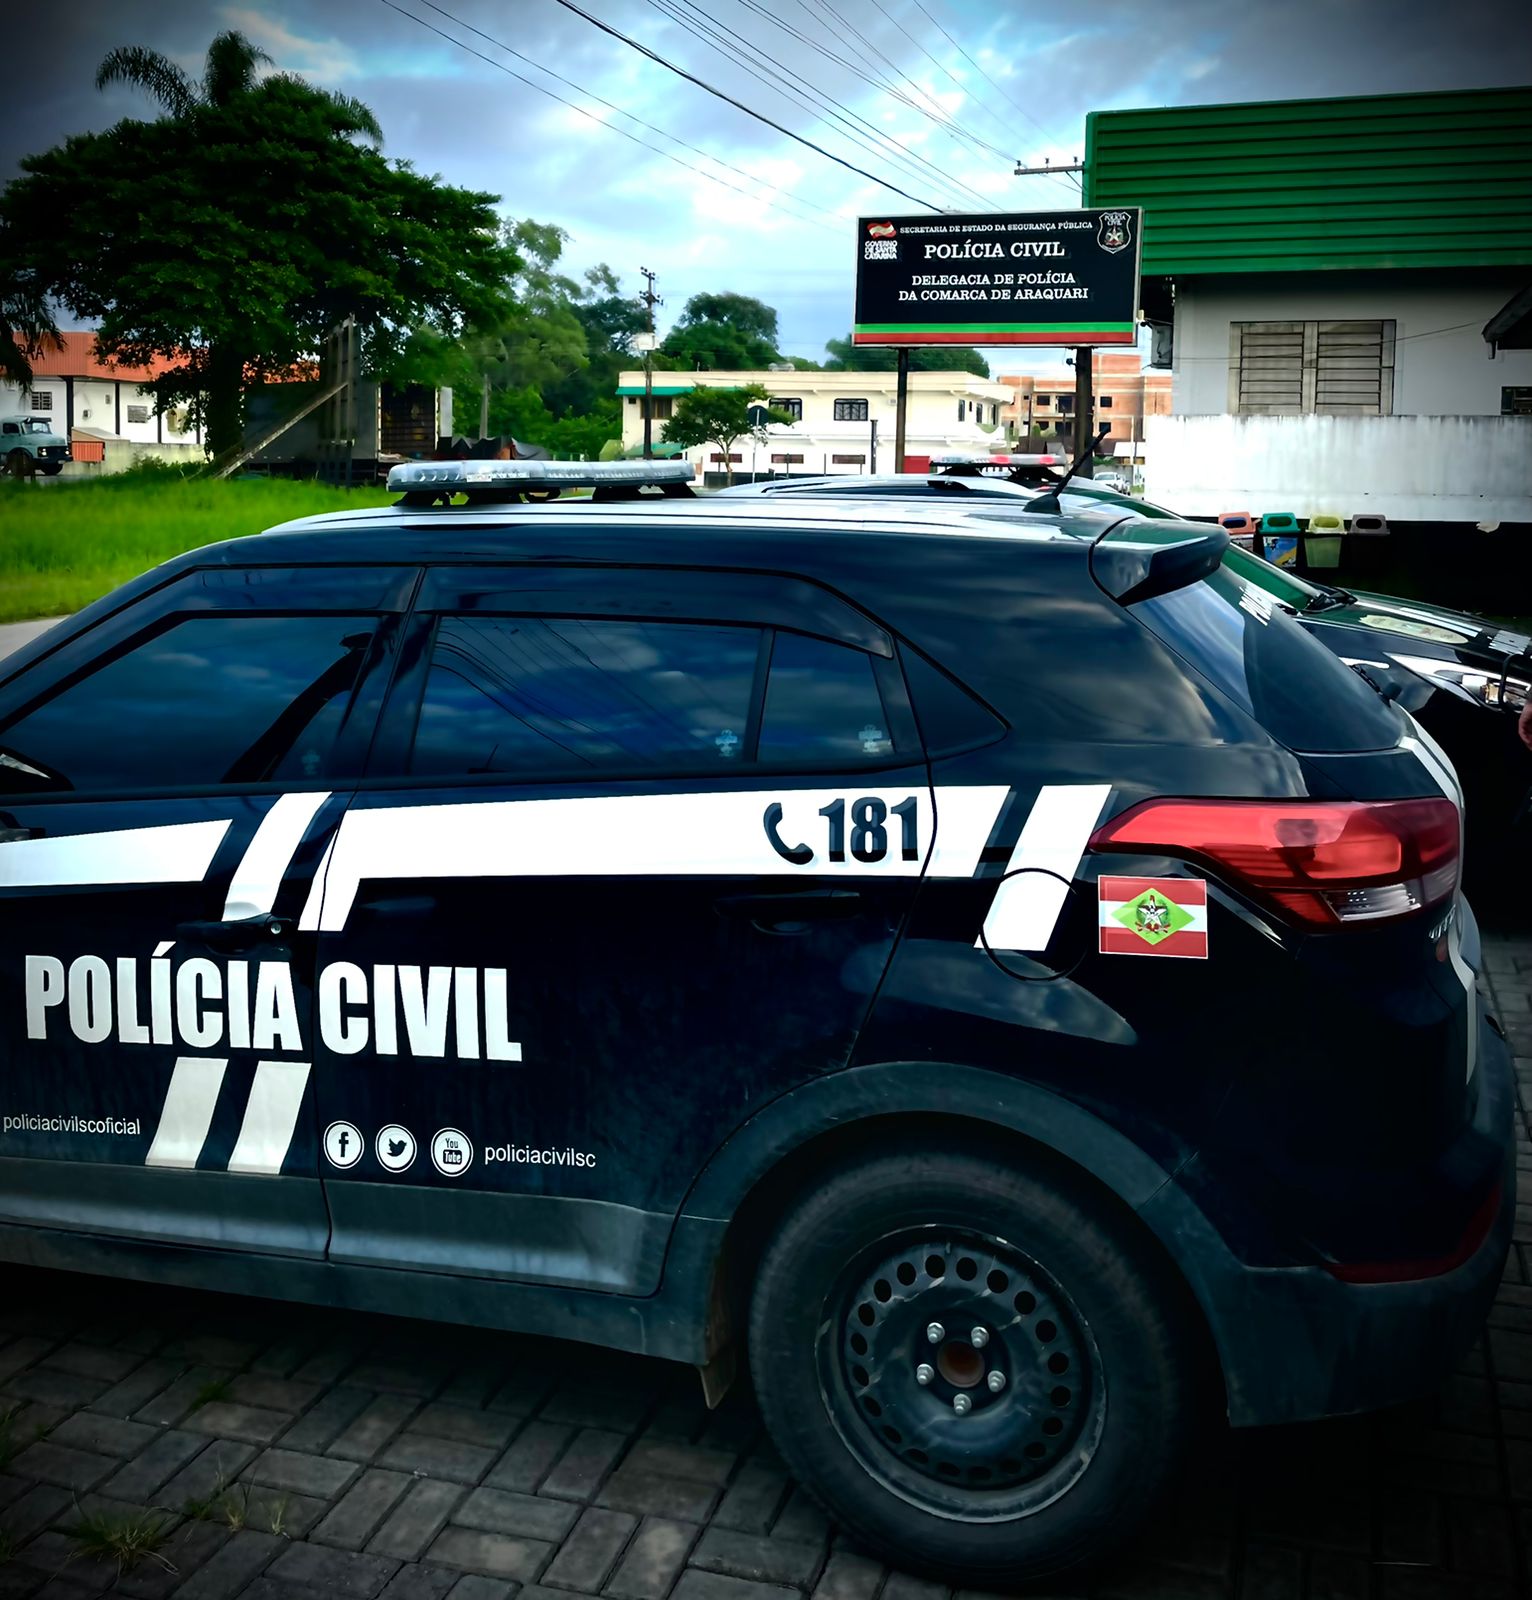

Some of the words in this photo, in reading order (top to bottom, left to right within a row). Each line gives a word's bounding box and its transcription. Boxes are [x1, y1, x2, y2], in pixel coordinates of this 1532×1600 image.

[900, 225, 948, 234] SECRETARIA
[1007, 222, 1056, 231] SEGURANÇA
[1058, 221, 1093, 230] PÚBLICA
[924, 239, 1005, 259] POLÍCIA
[1010, 241, 1065, 257] CIVIL
[912, 274, 991, 286] DELEGACIA
[993, 273, 1014, 285] DE
[1017, 270, 1076, 285] POLÍCIA
[899, 290, 918, 301] DA
[920, 289, 990, 300] COMARCA
[991, 289, 1011, 300] DE
[1014, 287, 1089, 300] ARAQUARI
[818, 796, 919, 863] 181
[25, 941, 303, 1051] POLÍCIA
[318, 961, 523, 1062] CIVIL
[3, 1113, 140, 1135] policiacivilscoficial
[445, 1138, 459, 1149] You
[444, 1151, 462, 1164] Tube
[485, 1144, 596, 1168] policiacivilsc
